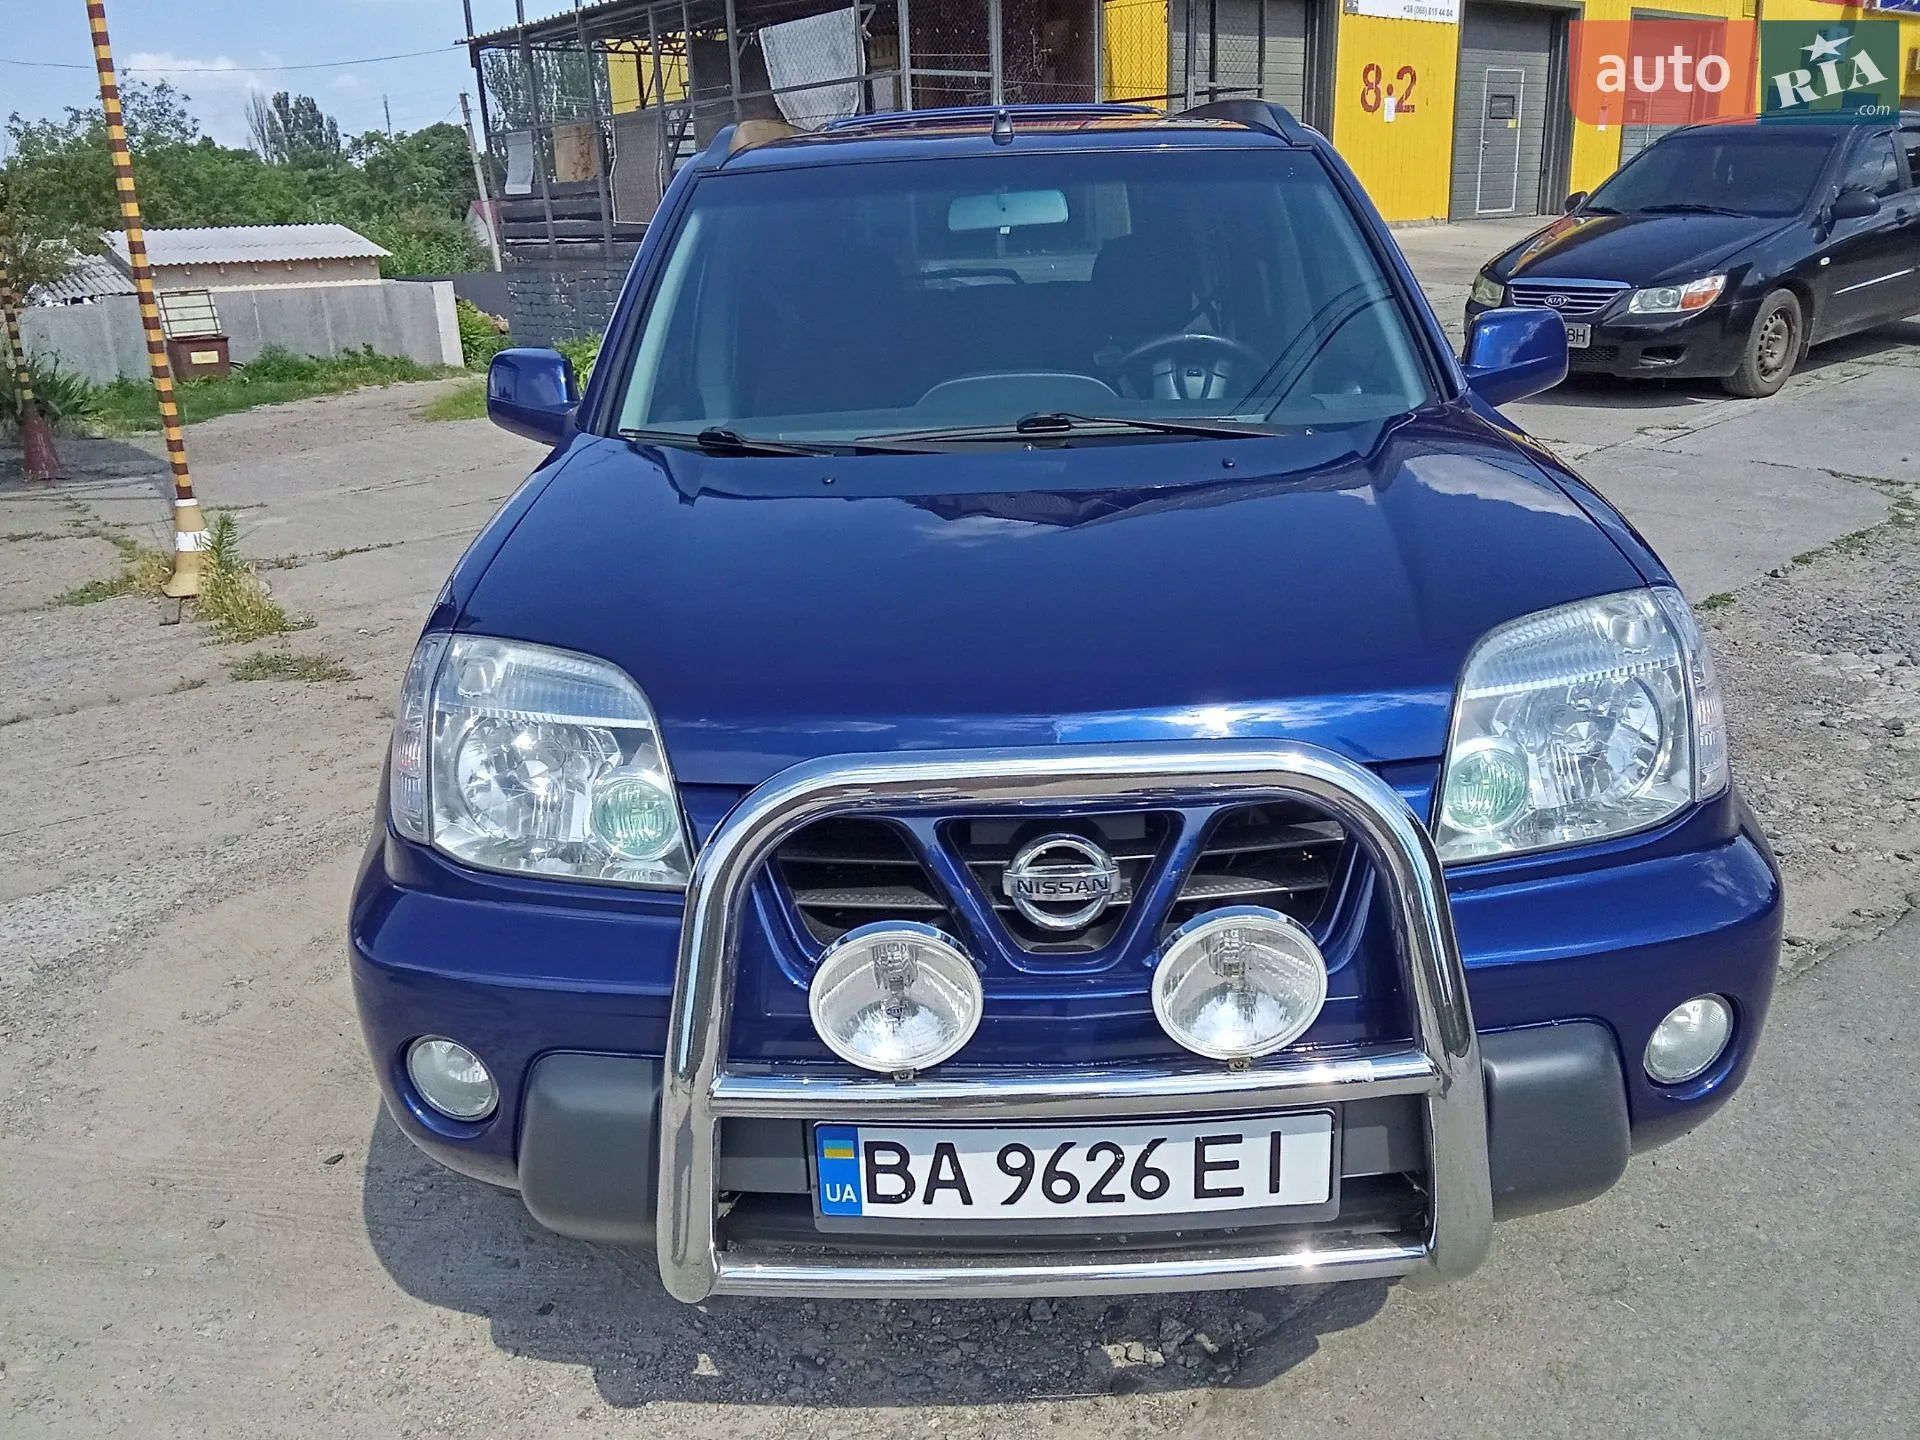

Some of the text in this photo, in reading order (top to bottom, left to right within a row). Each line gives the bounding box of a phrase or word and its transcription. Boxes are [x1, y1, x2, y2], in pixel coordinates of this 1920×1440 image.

[1017, 877, 1108, 895] NISSAN
[863, 1131, 1281, 1206] BA 9626 EI
[826, 1184, 857, 1203] UA
